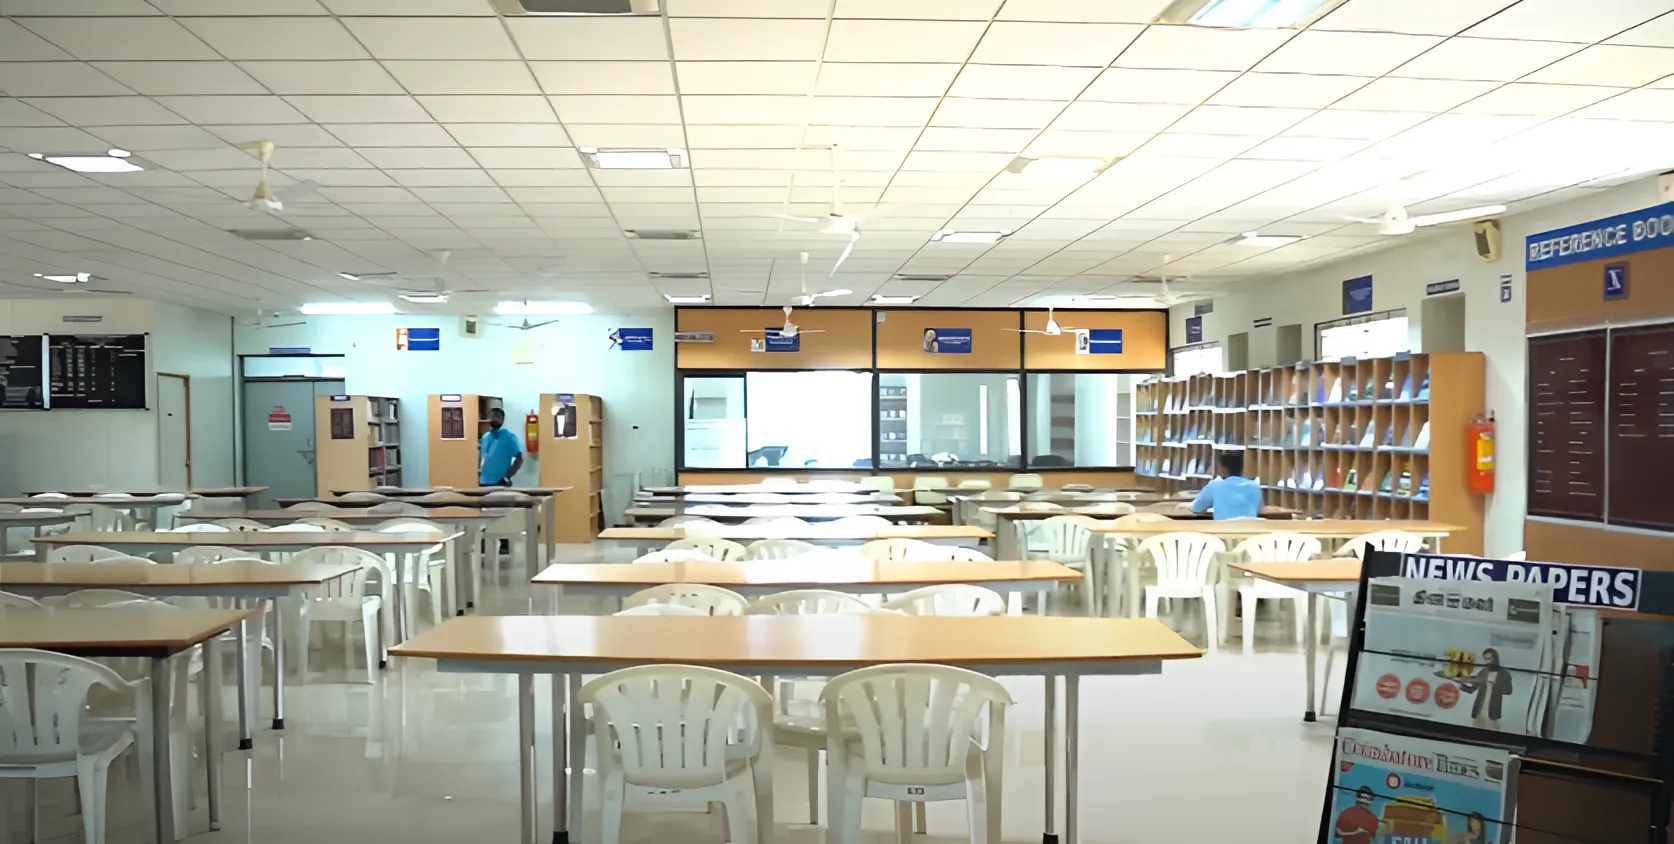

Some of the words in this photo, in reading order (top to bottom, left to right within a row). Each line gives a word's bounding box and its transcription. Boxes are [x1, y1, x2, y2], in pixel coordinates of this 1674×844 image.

[1529, 223, 1628, 262] REFERENCE
[1405, 556, 1494, 582] NEWS
[1506, 564, 1635, 607] PAPERS
